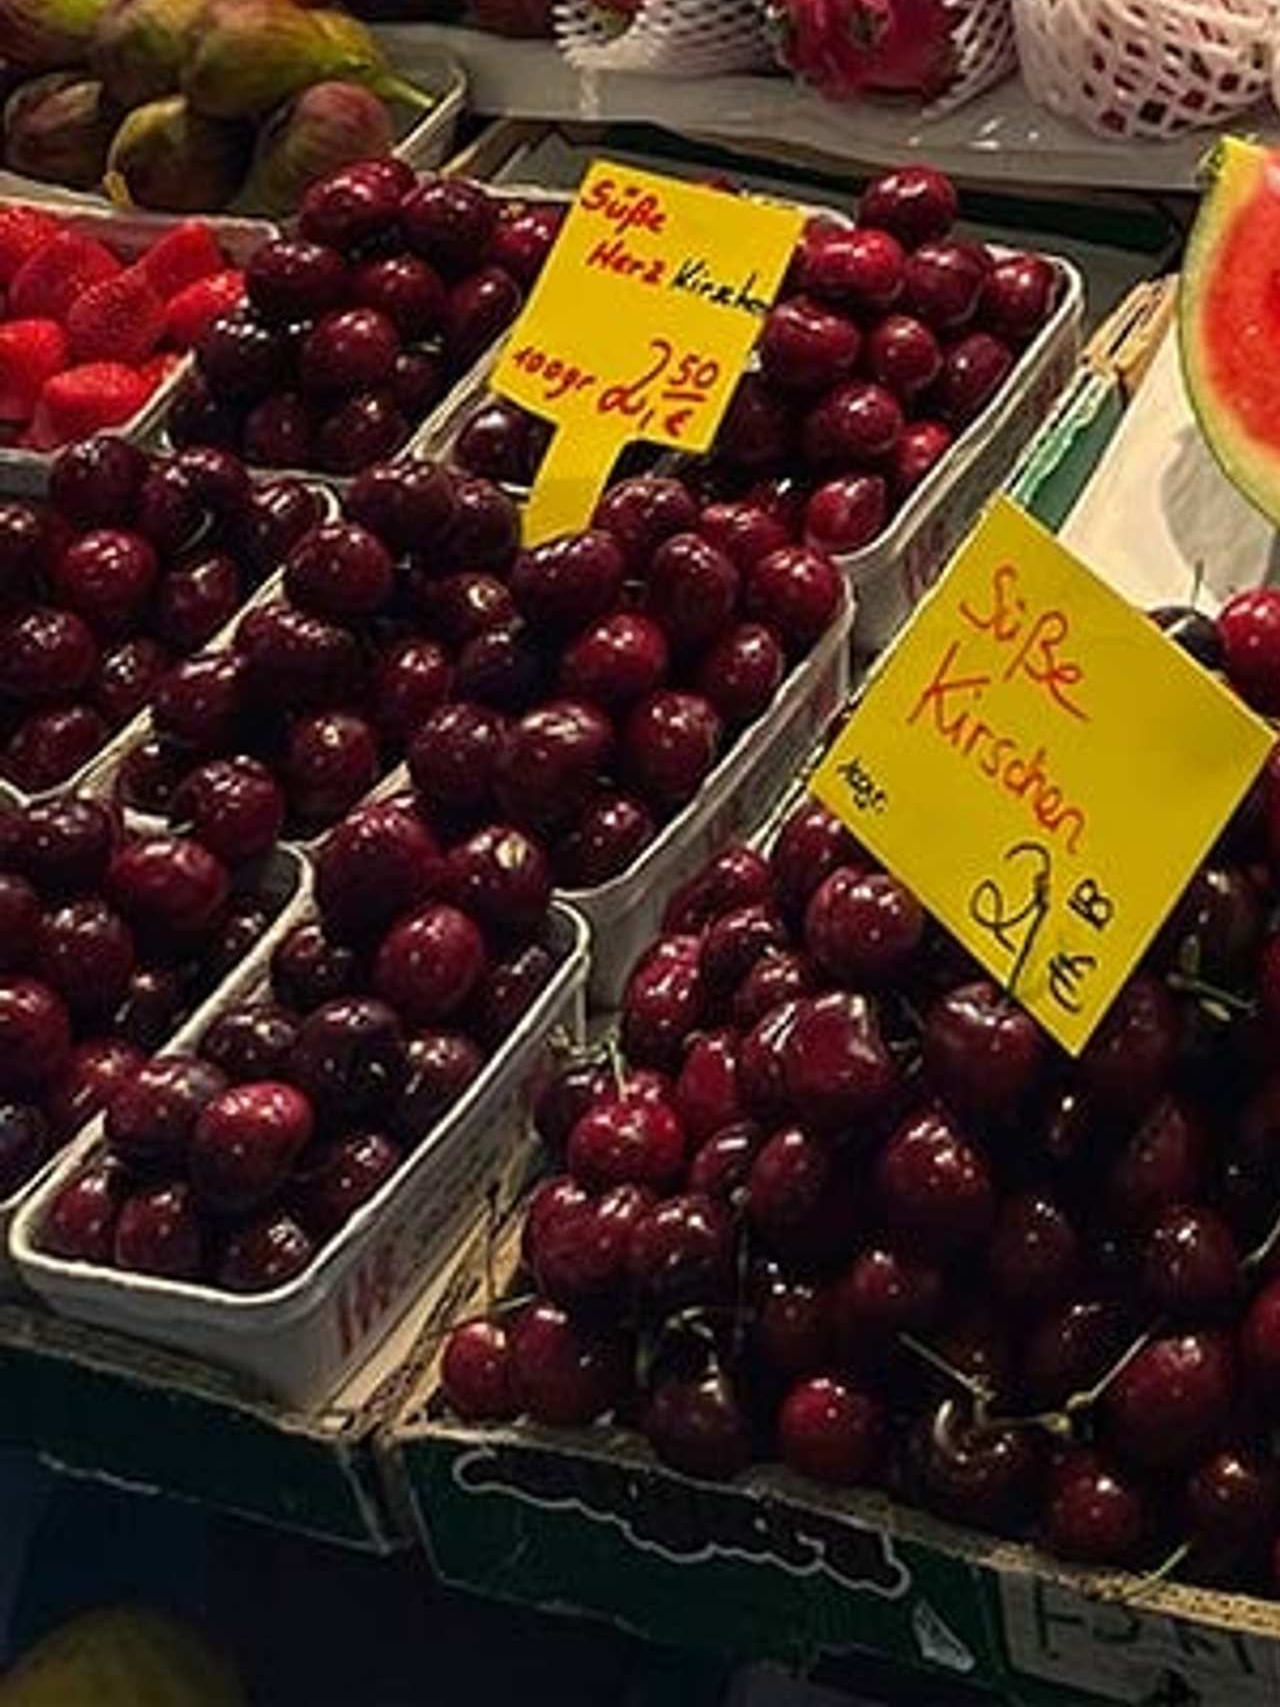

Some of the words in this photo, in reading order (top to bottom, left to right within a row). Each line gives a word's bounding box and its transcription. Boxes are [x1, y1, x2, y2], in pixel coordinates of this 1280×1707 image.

[579, 178, 670, 236] Süße
[583, 237, 667, 286] Herz
[958, 562, 1092, 723] Süße
[904, 640, 1090, 858] Kirschen
